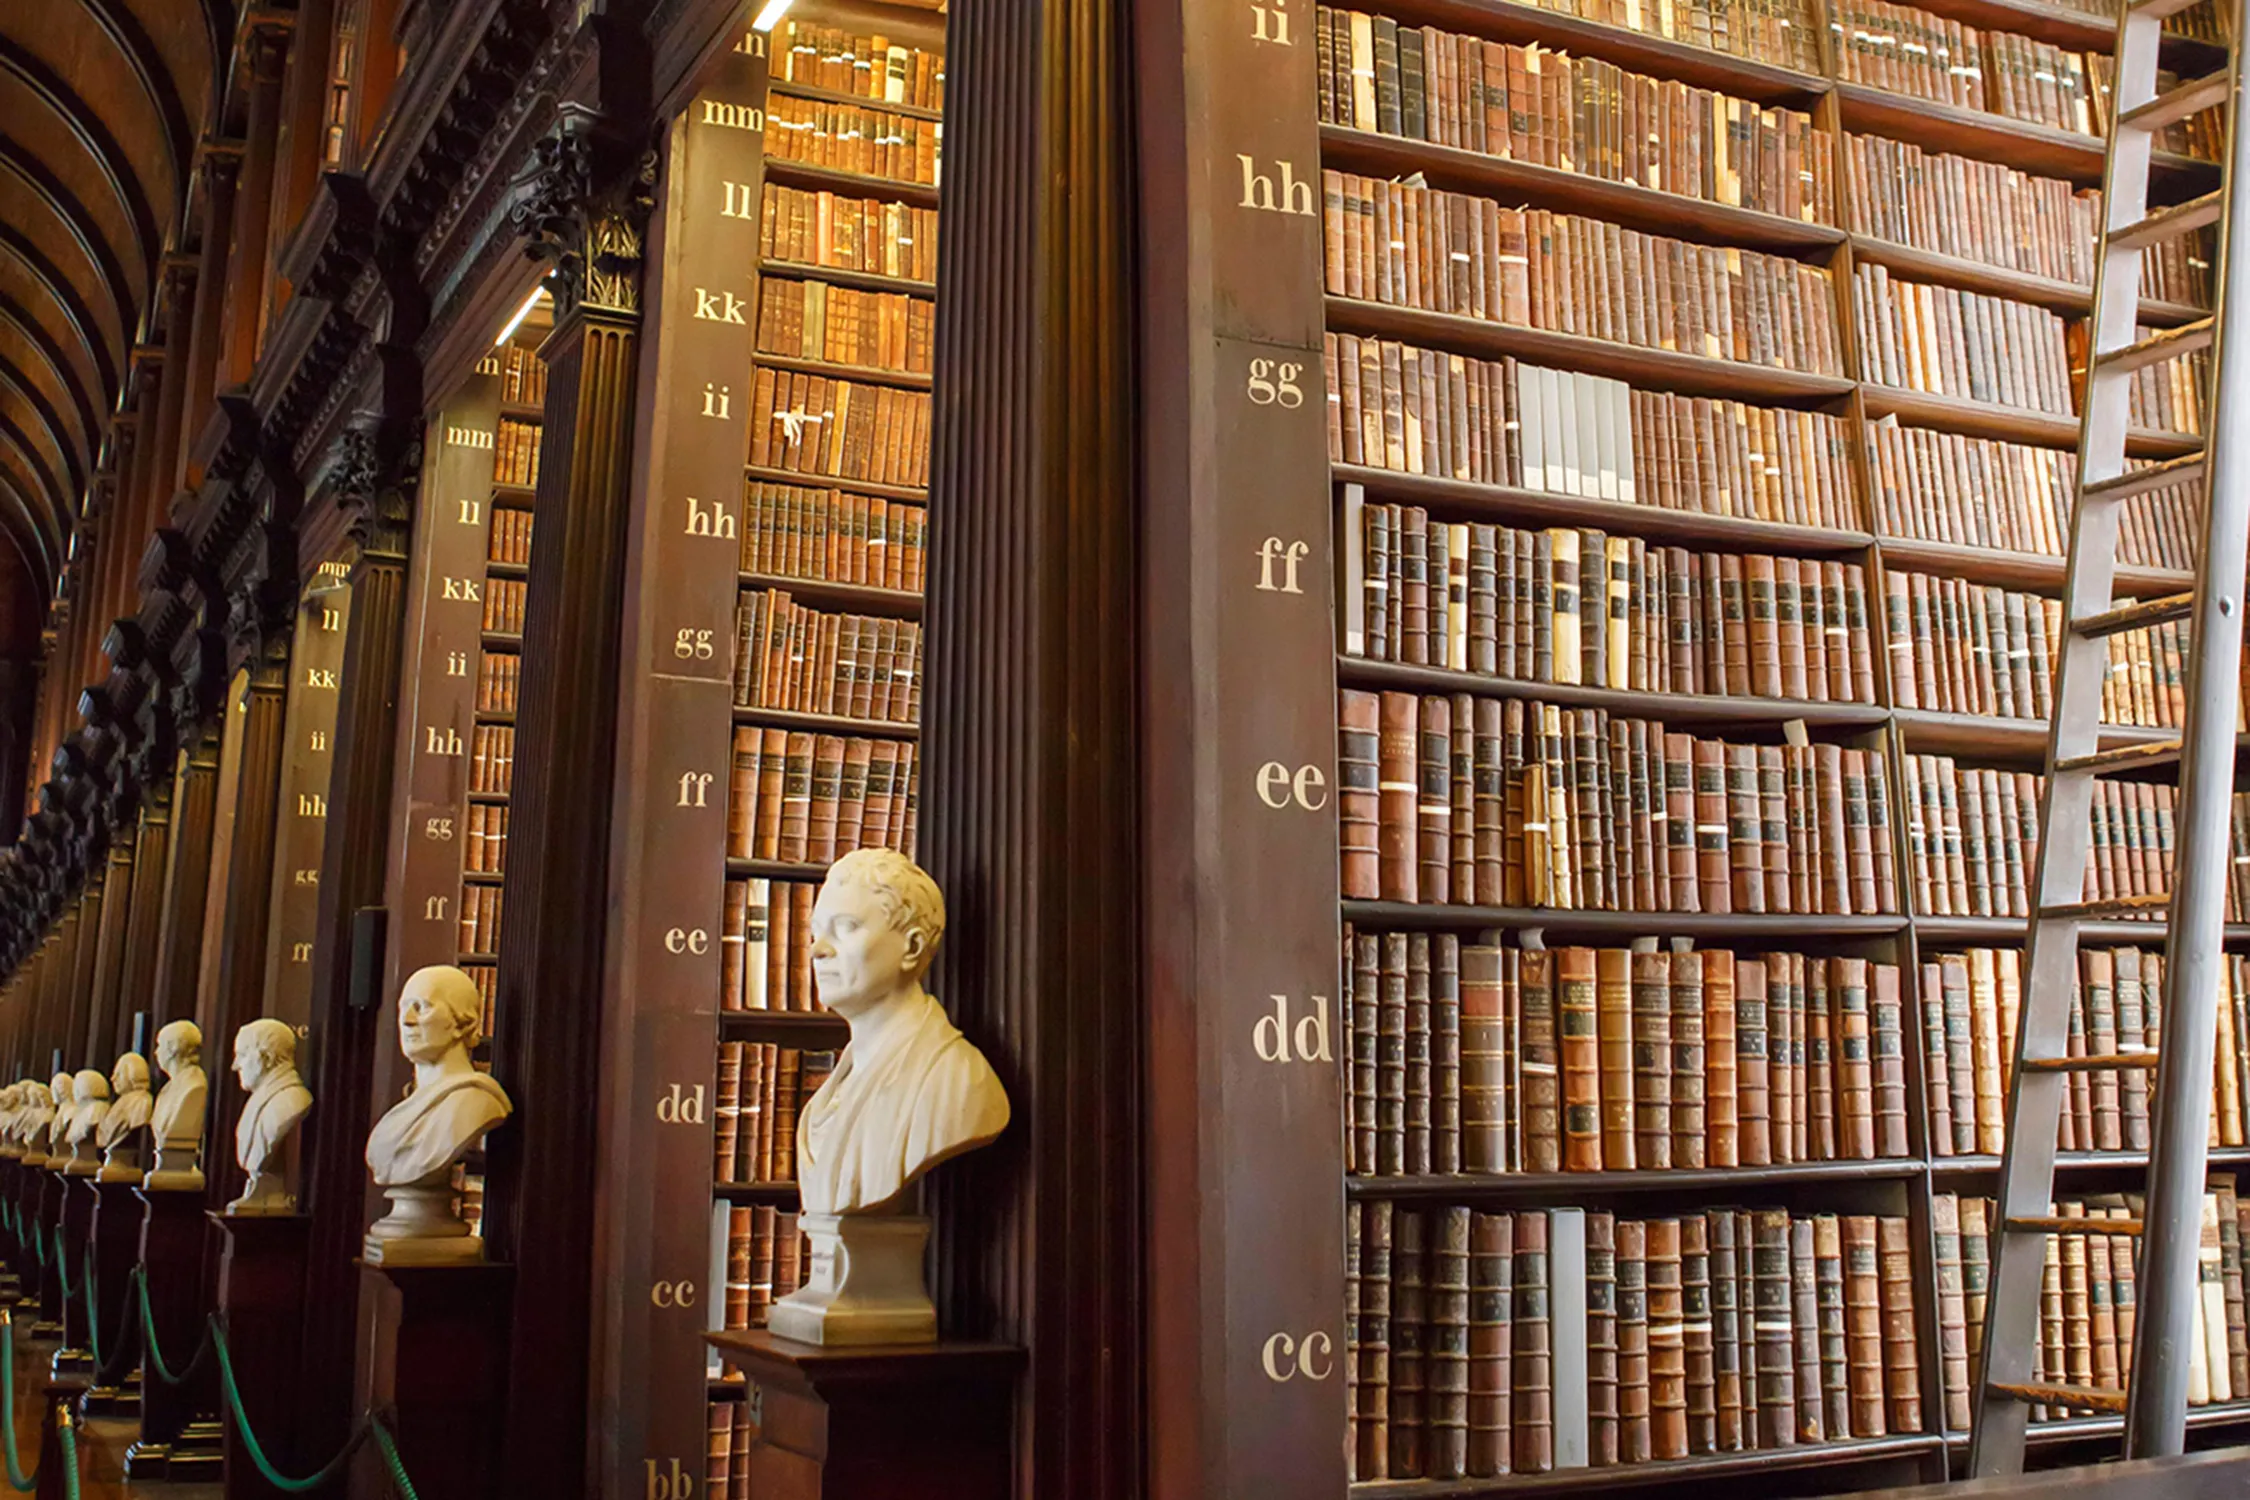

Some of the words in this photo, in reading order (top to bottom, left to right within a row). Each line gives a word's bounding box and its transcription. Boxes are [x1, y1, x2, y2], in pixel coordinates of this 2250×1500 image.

[1251, 0, 1292, 45] ii
[702, 101, 762, 132] mm
[721, 182, 751, 219] ll
[1237, 154, 1316, 216] hh
[694, 288, 745, 324] kk
[1248, 359, 1302, 408] gg
[702, 383, 729, 419] ii
[448, 428, 492, 448] mm
[459, 500, 479, 524] ll
[685, 498, 735, 538] hh
[1256, 537, 1308, 593] ff
[443, 578, 479, 601] kk
[323, 610, 338, 631] ll
[674, 628, 713, 659] gg
[309, 669, 335, 688] kk
[448, 652, 465, 676] ii
[312, 732, 324, 750] ii
[427, 727, 462, 755] hh
[678, 772, 713, 806] ff
[1257, 762, 1326, 810] ee
[300, 795, 326, 816] hh
[426, 818, 452, 840] gg
[424, 896, 448, 920] ff
[293, 944, 312, 961] ff
[666, 929, 707, 954] ee
[1254, 995, 1333, 1062] dd
[658, 1084, 704, 1123] dd
[652, 1281, 693, 1307] cc
[1263, 1332, 1332, 1381] cc
[645, 1458, 692, 1500] bb
